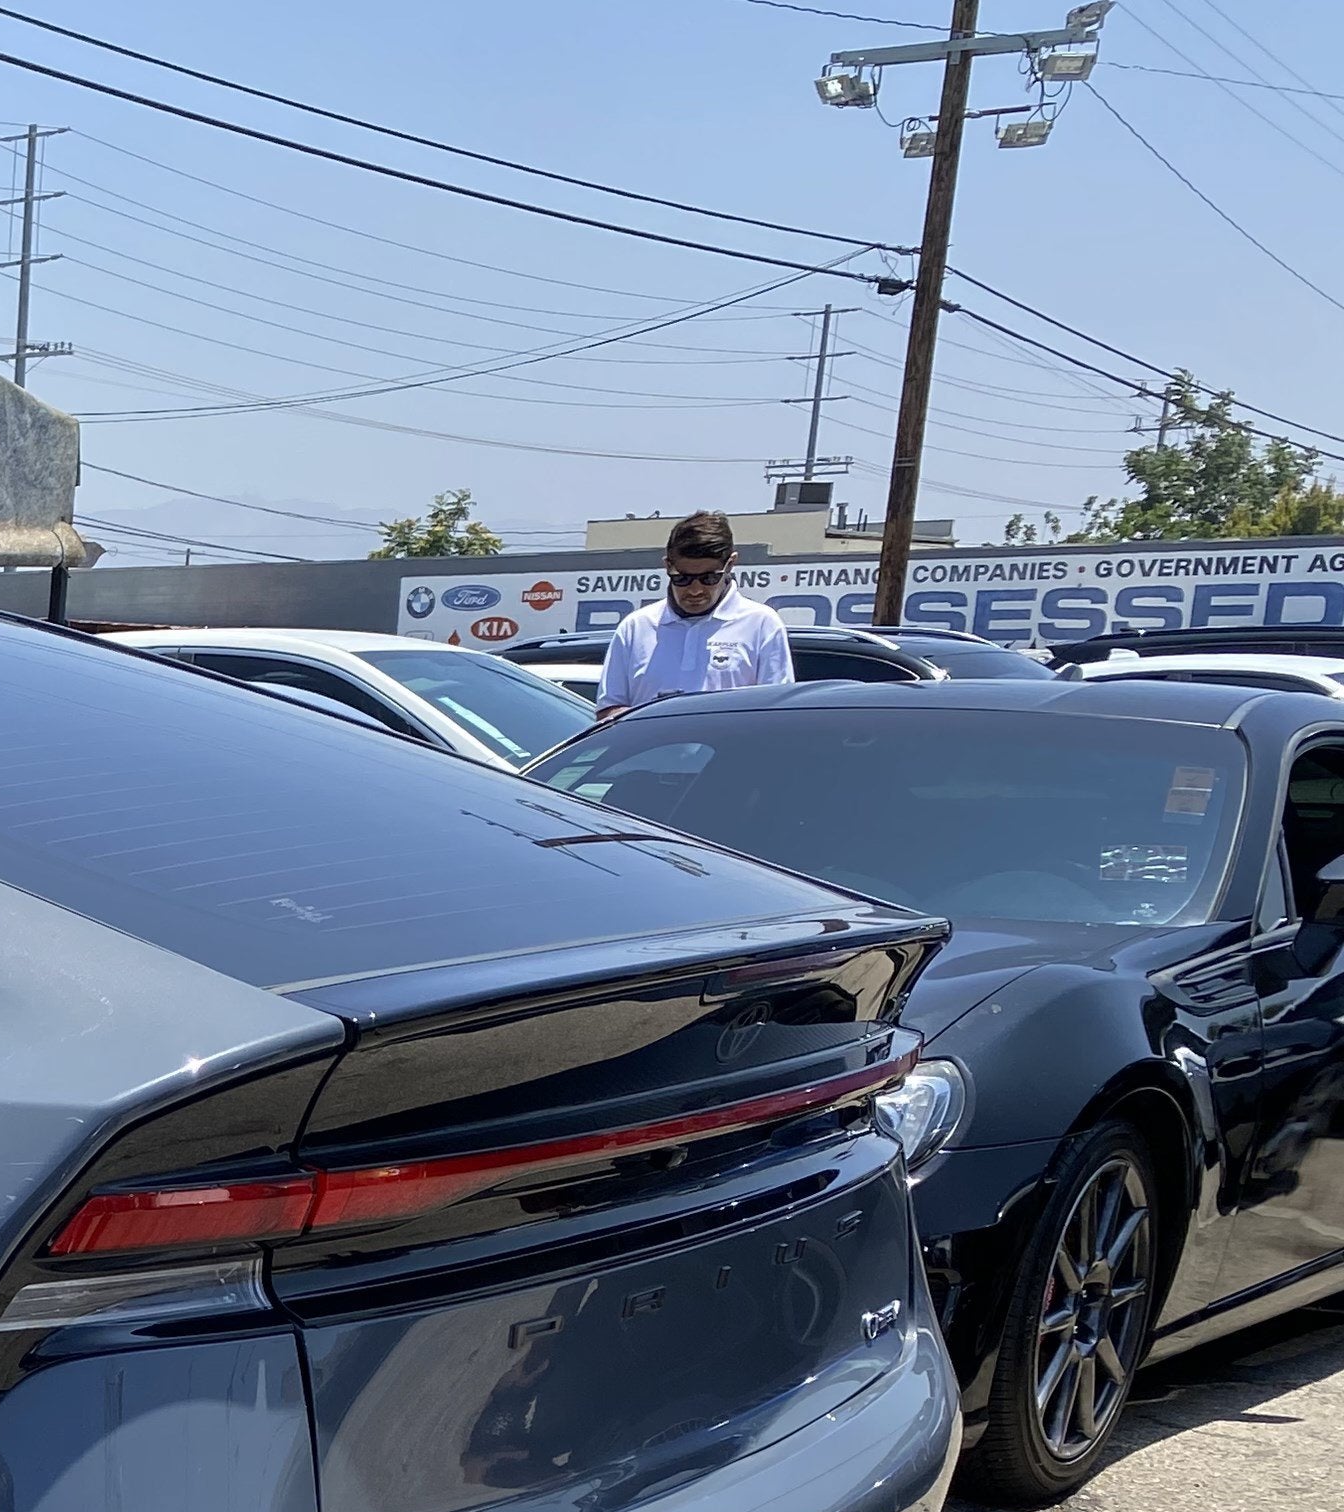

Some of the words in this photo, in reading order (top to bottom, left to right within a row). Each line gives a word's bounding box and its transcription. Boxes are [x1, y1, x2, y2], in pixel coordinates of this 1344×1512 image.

[795, 566, 880, 587] FINANC
[912, 561, 1068, 583] COMPANIES
[1094, 554, 1299, 579] GOVERNMENT
[453, 590, 489, 606] Ford
[523, 589, 562, 602] NISSAN
[575, 581, 1344, 641] ROSSESSED
[477, 621, 512, 637] KIA
